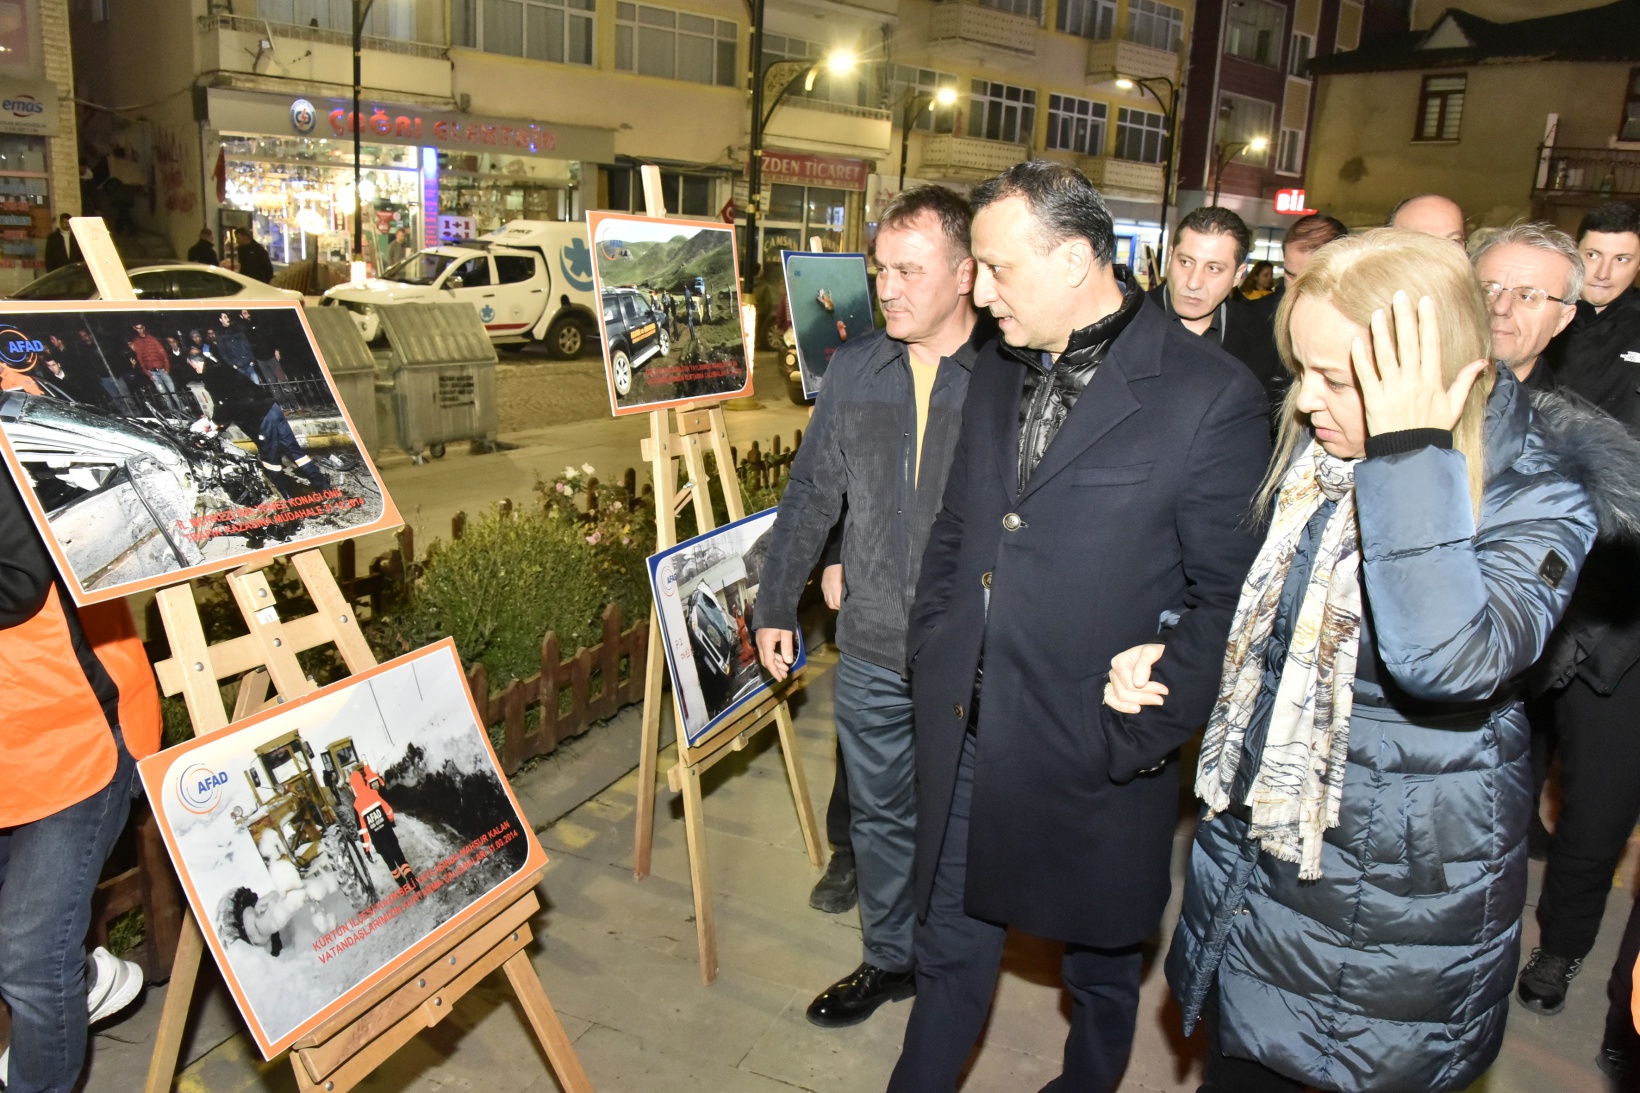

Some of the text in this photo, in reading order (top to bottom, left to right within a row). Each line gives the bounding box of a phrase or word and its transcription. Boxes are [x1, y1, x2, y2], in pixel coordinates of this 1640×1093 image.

[2, 100, 43, 113] emas
[762, 156, 860, 180] ZDEN TİCARET
[8, 339, 44, 353] AFAD
[189, 507, 236, 528] MERKEZİ
[288, 491, 323, 507] KONAĞI
[223, 515, 274, 535] KAZASINA
[197, 771, 229, 795] AFAD
[366, 808, 382, 825] AFAD
[312, 922, 350, 952] KÜRTÜN
[348, 904, 376, 929] İLÇESİ
[459, 834, 489, 857] MAHSUR
[487, 820, 511, 840] KALAN
[318, 905, 402, 965] VATANDAŞLARIMIZIN
[401, 878, 443, 909] KURTARMA
